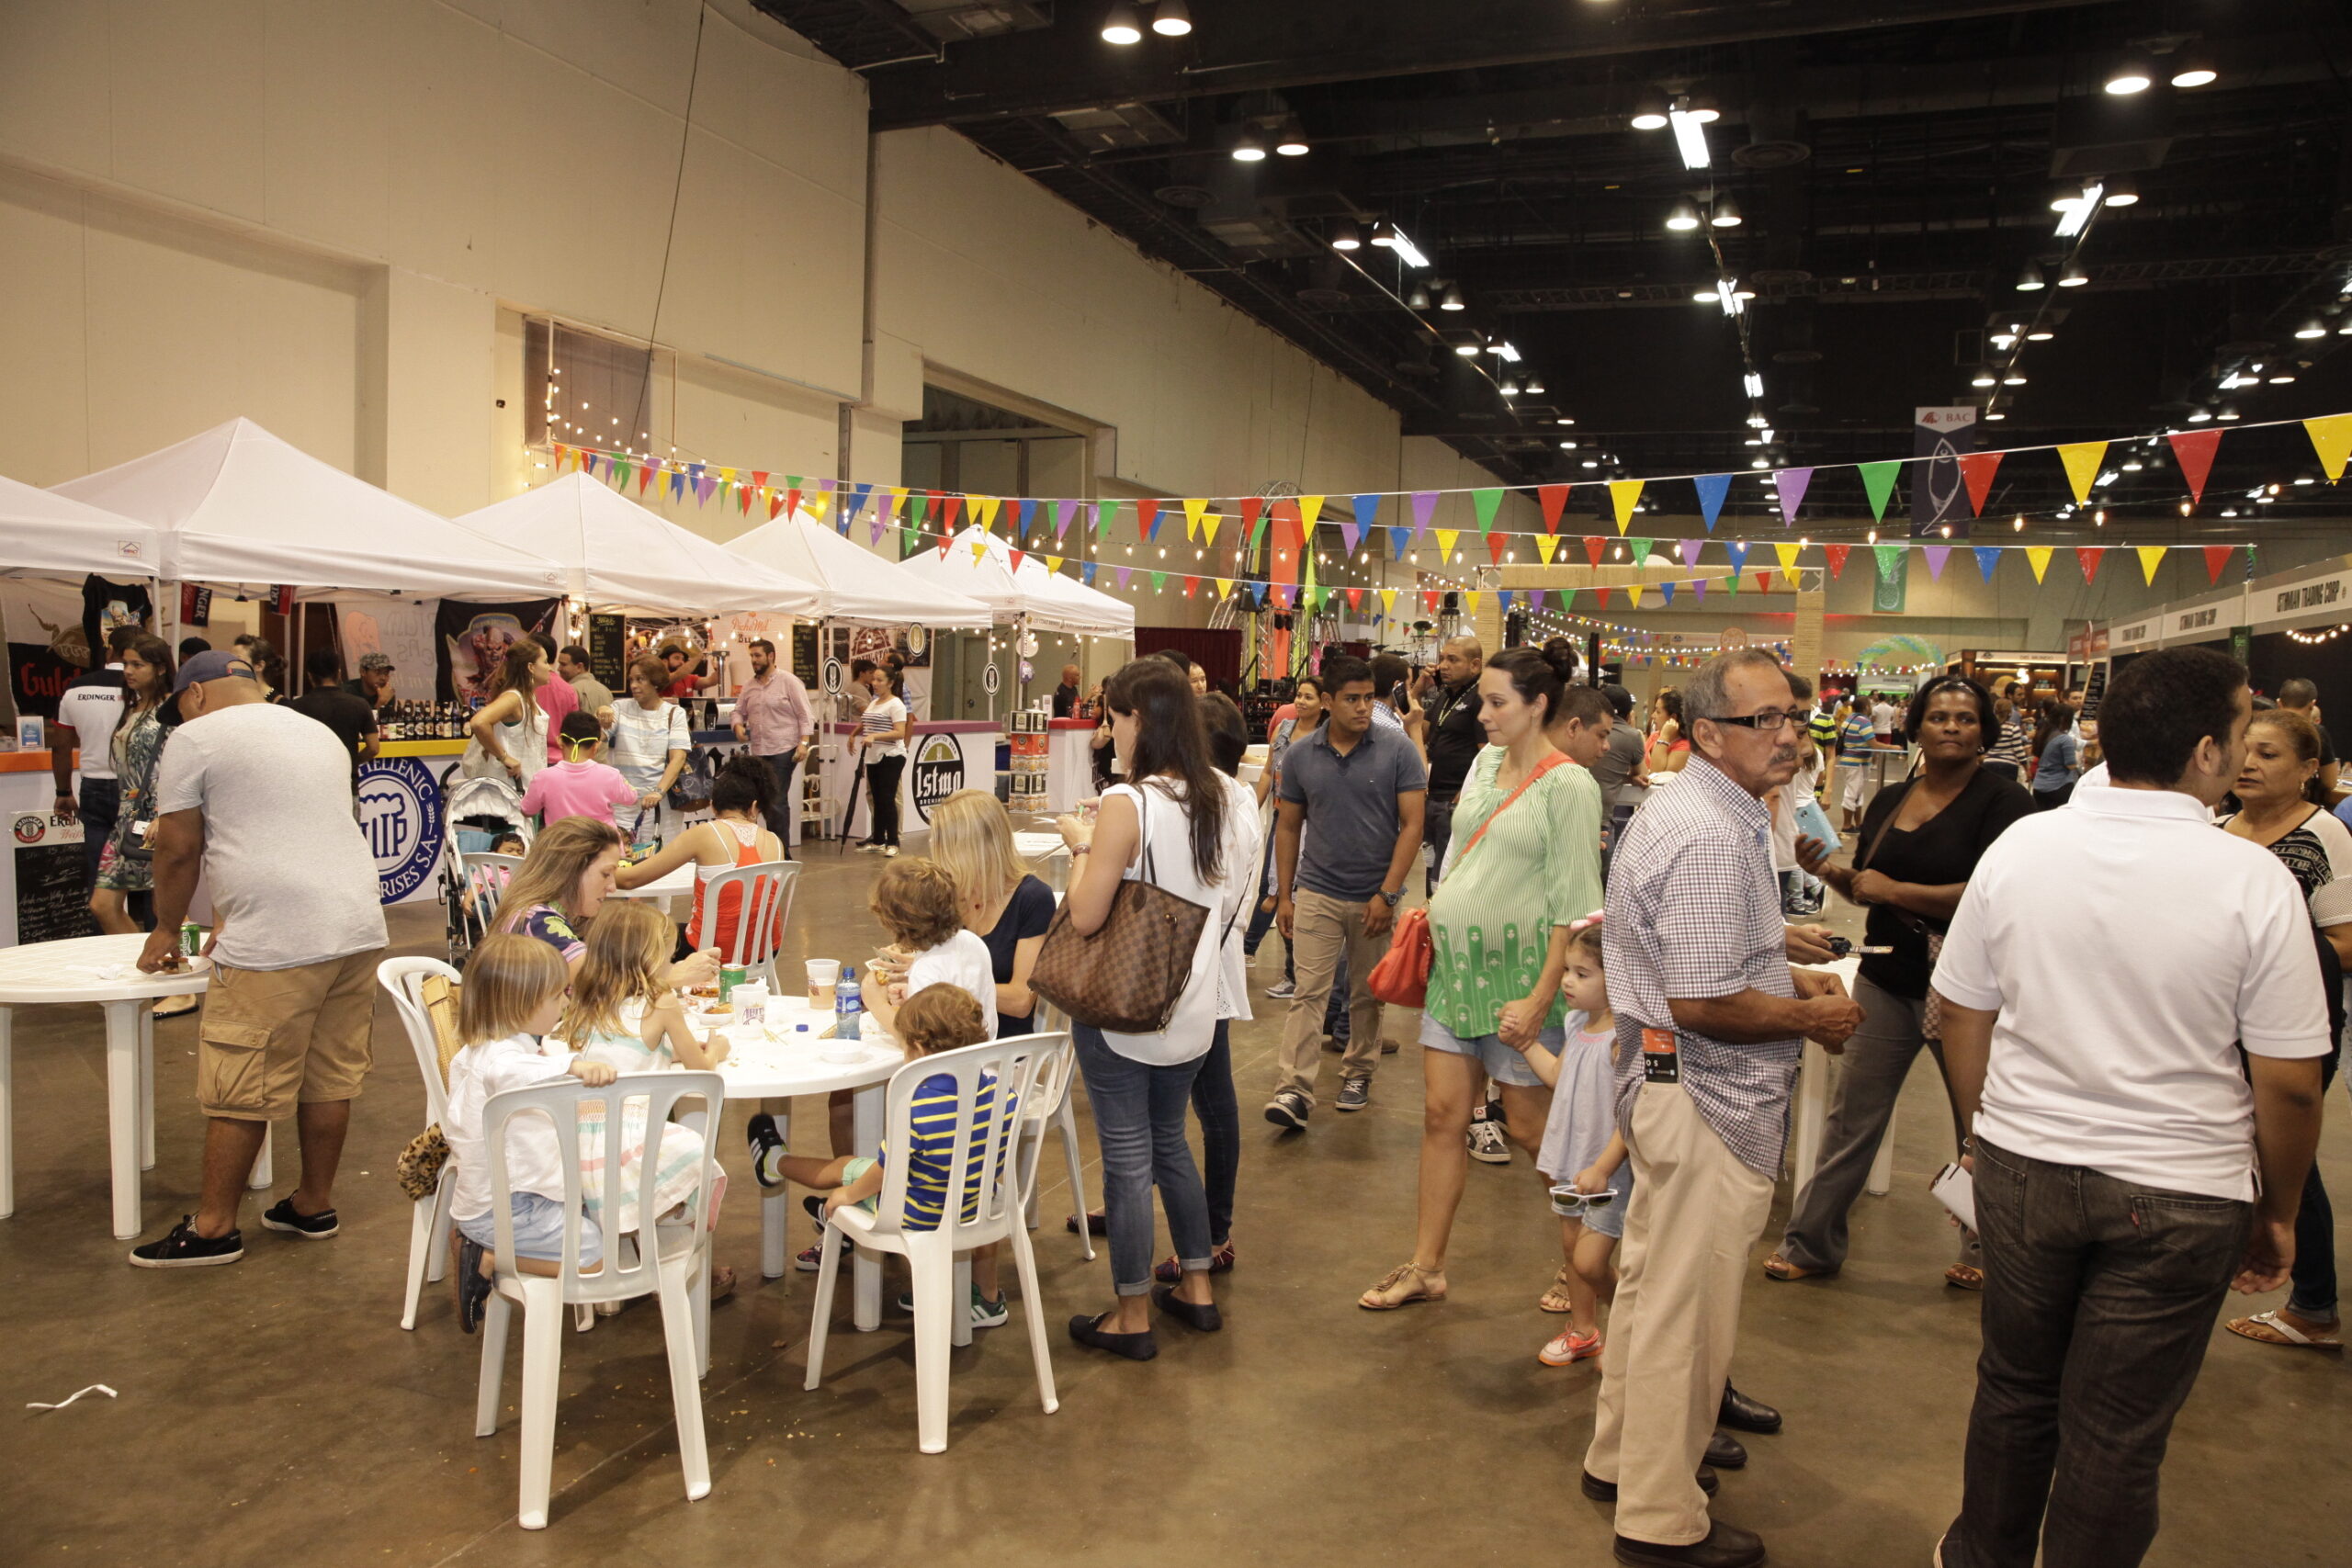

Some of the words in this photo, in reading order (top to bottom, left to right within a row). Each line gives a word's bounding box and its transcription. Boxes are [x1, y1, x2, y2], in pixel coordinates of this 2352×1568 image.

[1945, 412, 1971, 423] BAC
[195, 587, 210, 619] NGER
[77, 694, 116, 702] ERDINGER
[379, 865, 420, 898] RISES
